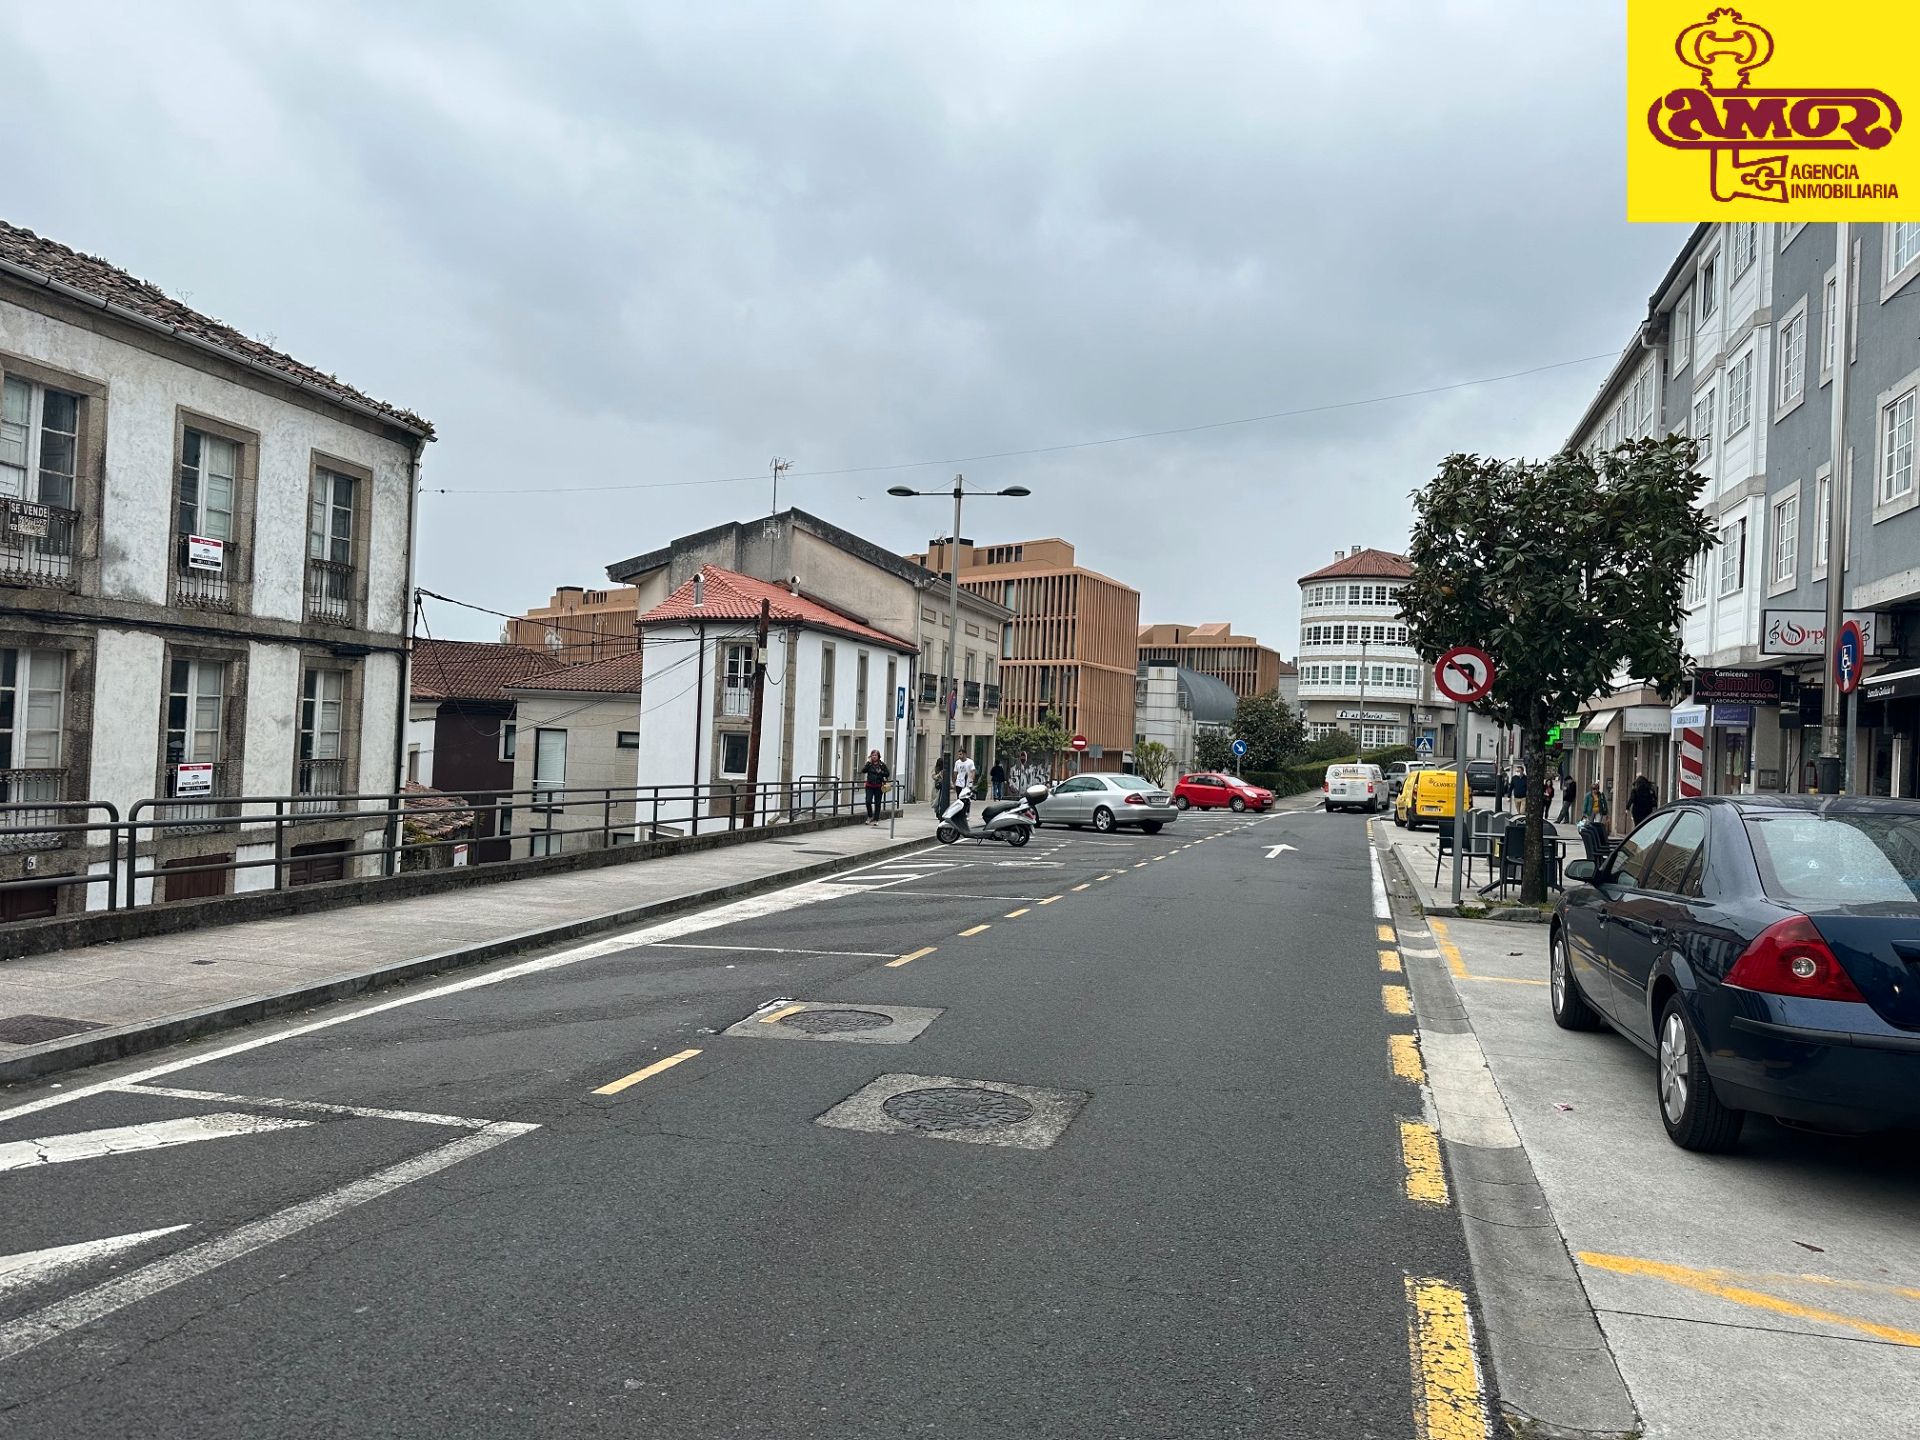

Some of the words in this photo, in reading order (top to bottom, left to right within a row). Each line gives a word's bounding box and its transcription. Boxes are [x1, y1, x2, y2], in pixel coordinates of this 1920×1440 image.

[11, 502, 20, 513] SE
[23, 504, 48, 517] VENDE
[1701, 671, 1775, 692] Camilo
